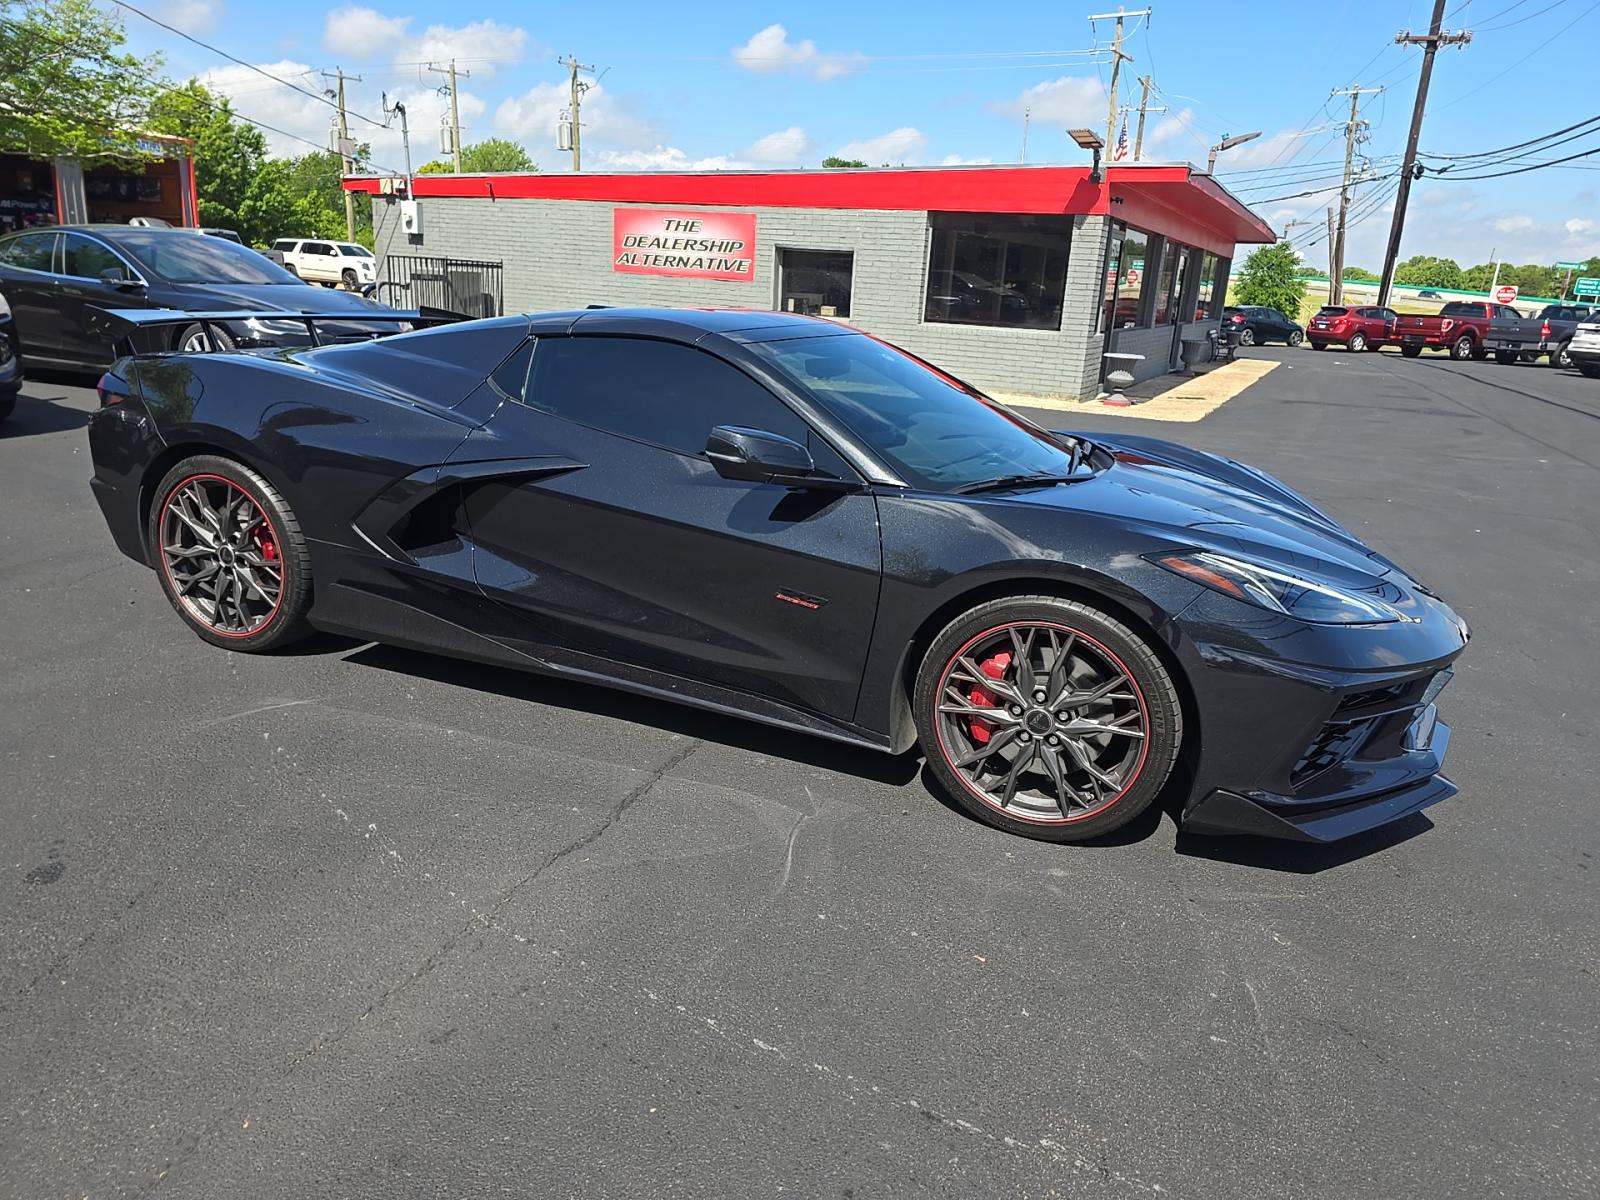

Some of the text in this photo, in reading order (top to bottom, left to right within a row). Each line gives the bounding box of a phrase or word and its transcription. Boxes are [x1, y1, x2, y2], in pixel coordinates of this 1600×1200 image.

[664, 219, 702, 233] THE
[623, 235, 744, 253] DEALERSHIP
[617, 252, 752, 273] ALTERNATIVE
